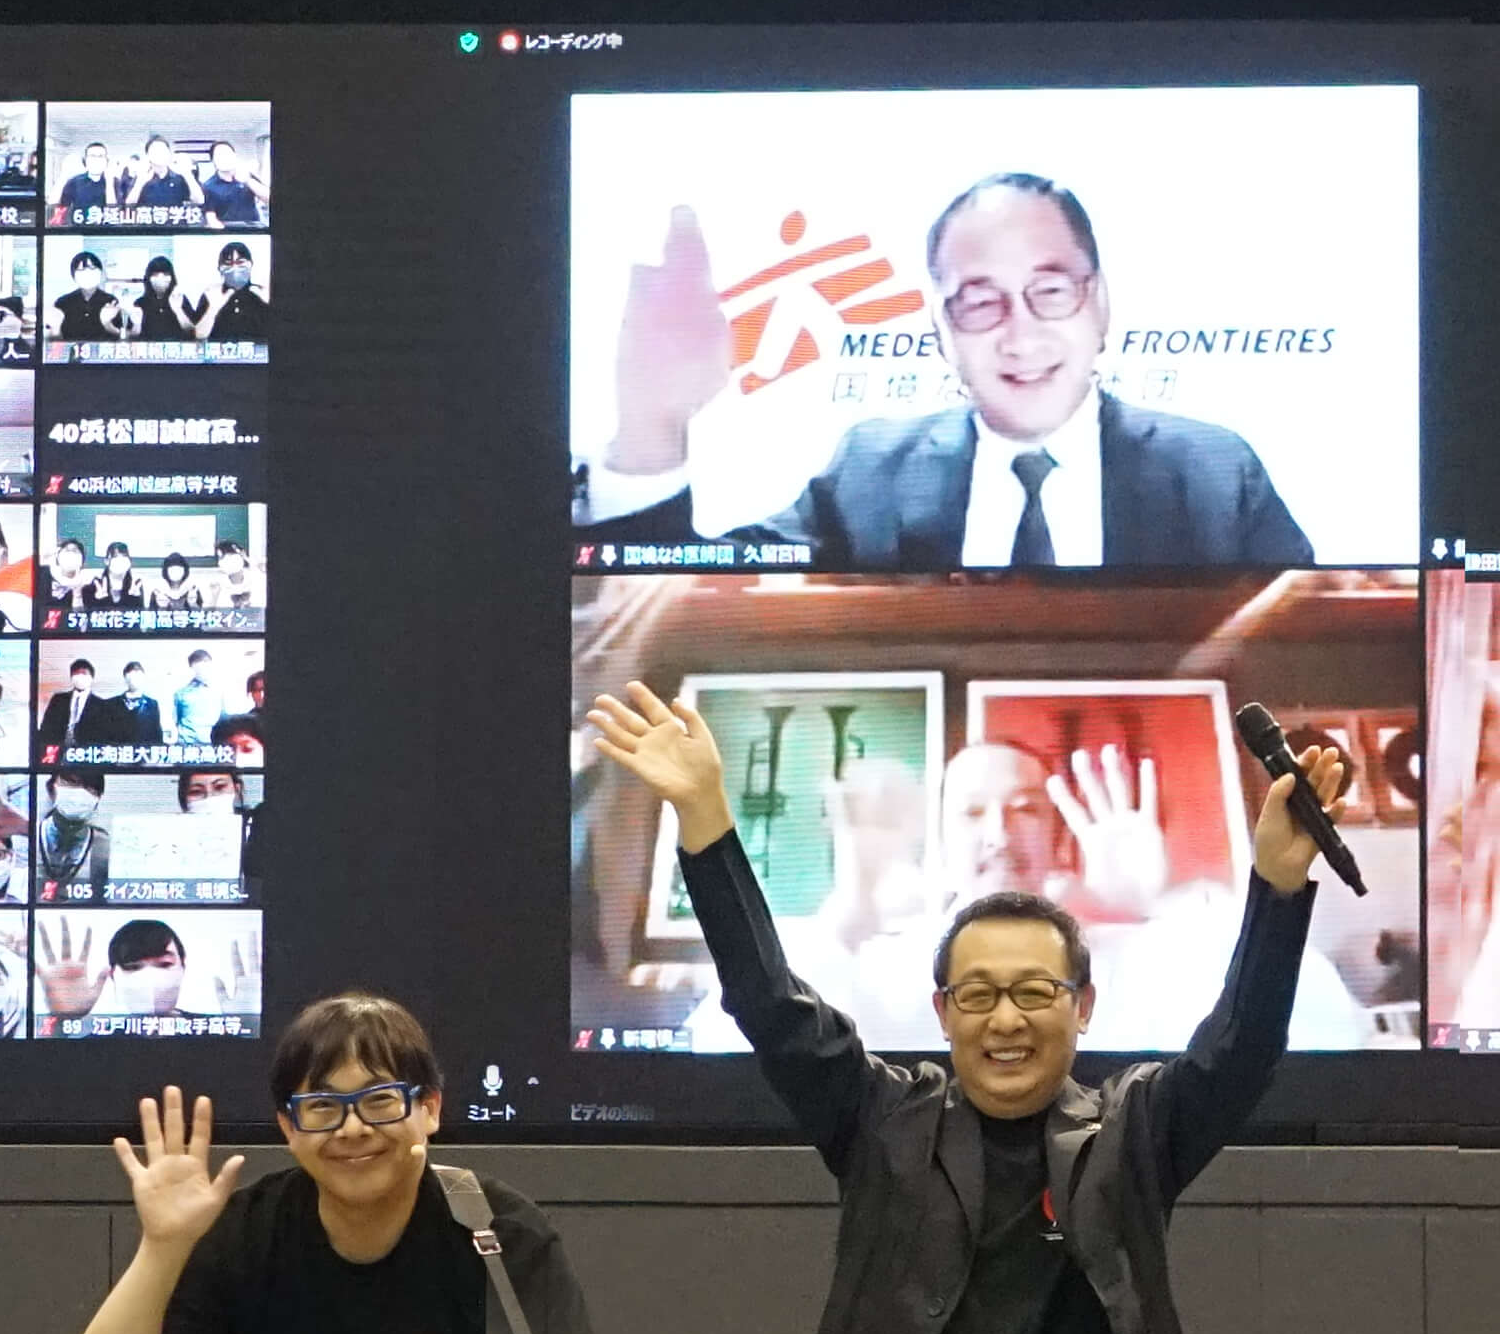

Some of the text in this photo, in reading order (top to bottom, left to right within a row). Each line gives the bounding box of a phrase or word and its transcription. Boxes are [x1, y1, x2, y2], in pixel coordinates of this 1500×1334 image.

[525, 33, 623, 50] レコーディング中
[74, 207, 202, 224] 6 身延山高等学校
[1121, 328, 1337, 355] FRONTIERES
[623, 545, 735, 565] 国境なき医師団
[68, 611, 88, 628] 57
[66, 882, 92, 899] 105
[104, 882, 185, 899] オイスカ高校
[63, 1017, 81, 1034] 89
[467, 1103, 517, 1121] ミュート
